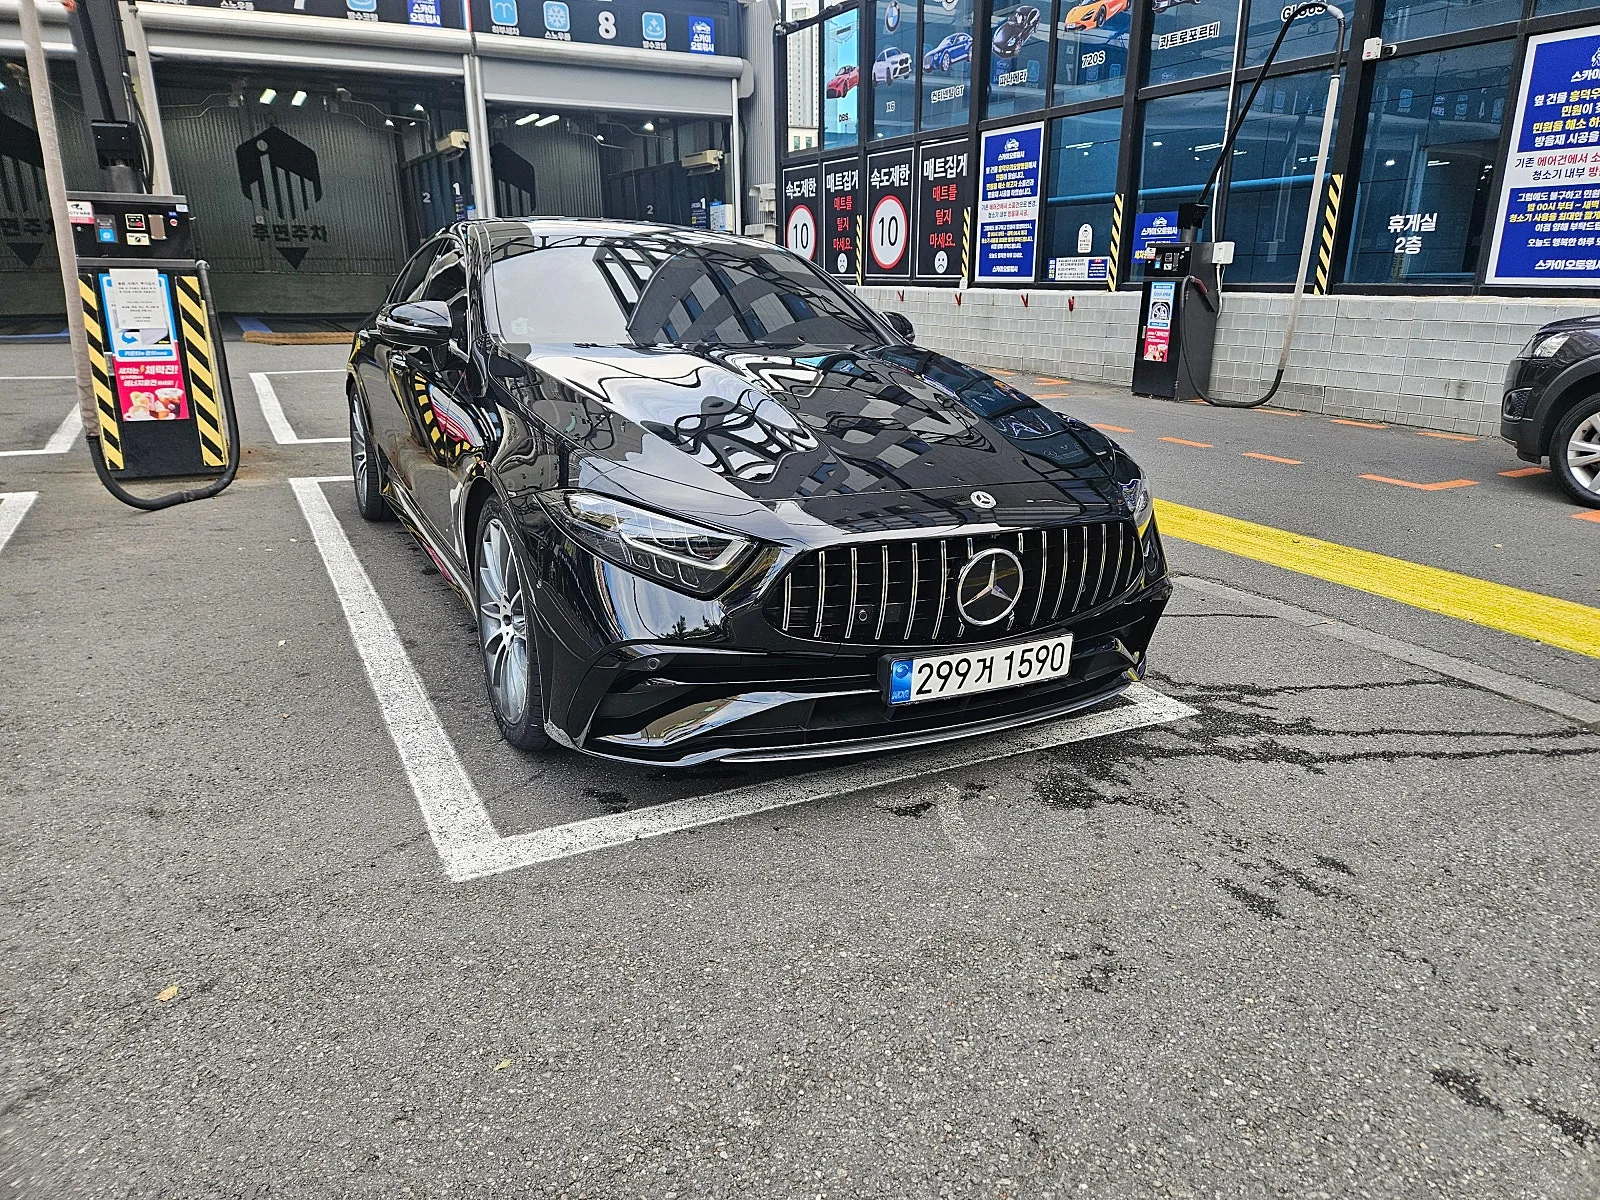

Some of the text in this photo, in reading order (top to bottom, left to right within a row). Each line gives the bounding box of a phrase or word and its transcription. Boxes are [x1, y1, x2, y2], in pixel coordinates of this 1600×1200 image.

[413, 3, 436, 14] 스카이
[598, 11, 617, 39] 8
[544, 30, 571, 41] 스노우폼
[693, 34, 711, 43] 스카이
[1159, 22, 1220, 49] 콰트로포르테
[690, 42, 714, 53] 오토워시
[1082, 51, 1105, 68] 720S
[955, 84, 964, 97] GT
[1546, 92, 1568, 105] 건물
[1561, 102, 1593, 117] 민원이
[1533, 120, 1563, 134] 민원을
[1565, 118, 1587, 130] 해소
[1534, 130, 1600, 147] 방음재 시공을
[1515, 157, 1535, 168] 기존
[1537, 152, 1588, 167] 에어건에서
[870, 164, 910, 189] 속도제한
[1532, 166, 1600, 181] 청소기 내부 방
[453, 182, 461, 196] 1
[785, 177, 816, 199] 속도제한
[932, 184, 957, 201] 매트를
[422, 192, 431, 203] 2
[700, 197, 706, 209] 1
[833, 195, 852, 211] 매트를
[1517, 192, 1549, 202] 그럼에도
[646, 204, 654, 215] 2
[1557, 201, 1574, 210] 부터
[837, 216, 849, 231] 털지
[935, 208, 952, 225] 털지
[1387, 212, 1438, 233] 휴게실
[878, 215, 898, 247] 10
[1535, 223, 1551, 231] 이점
[793, 222, 809, 249] 10
[929, 232, 956, 248] 마세요.
[1527, 238, 1551, 247] 오늘도
[1394, 235, 1422, 255] 2층
[915, 642, 1066, 696] 299거 1590
